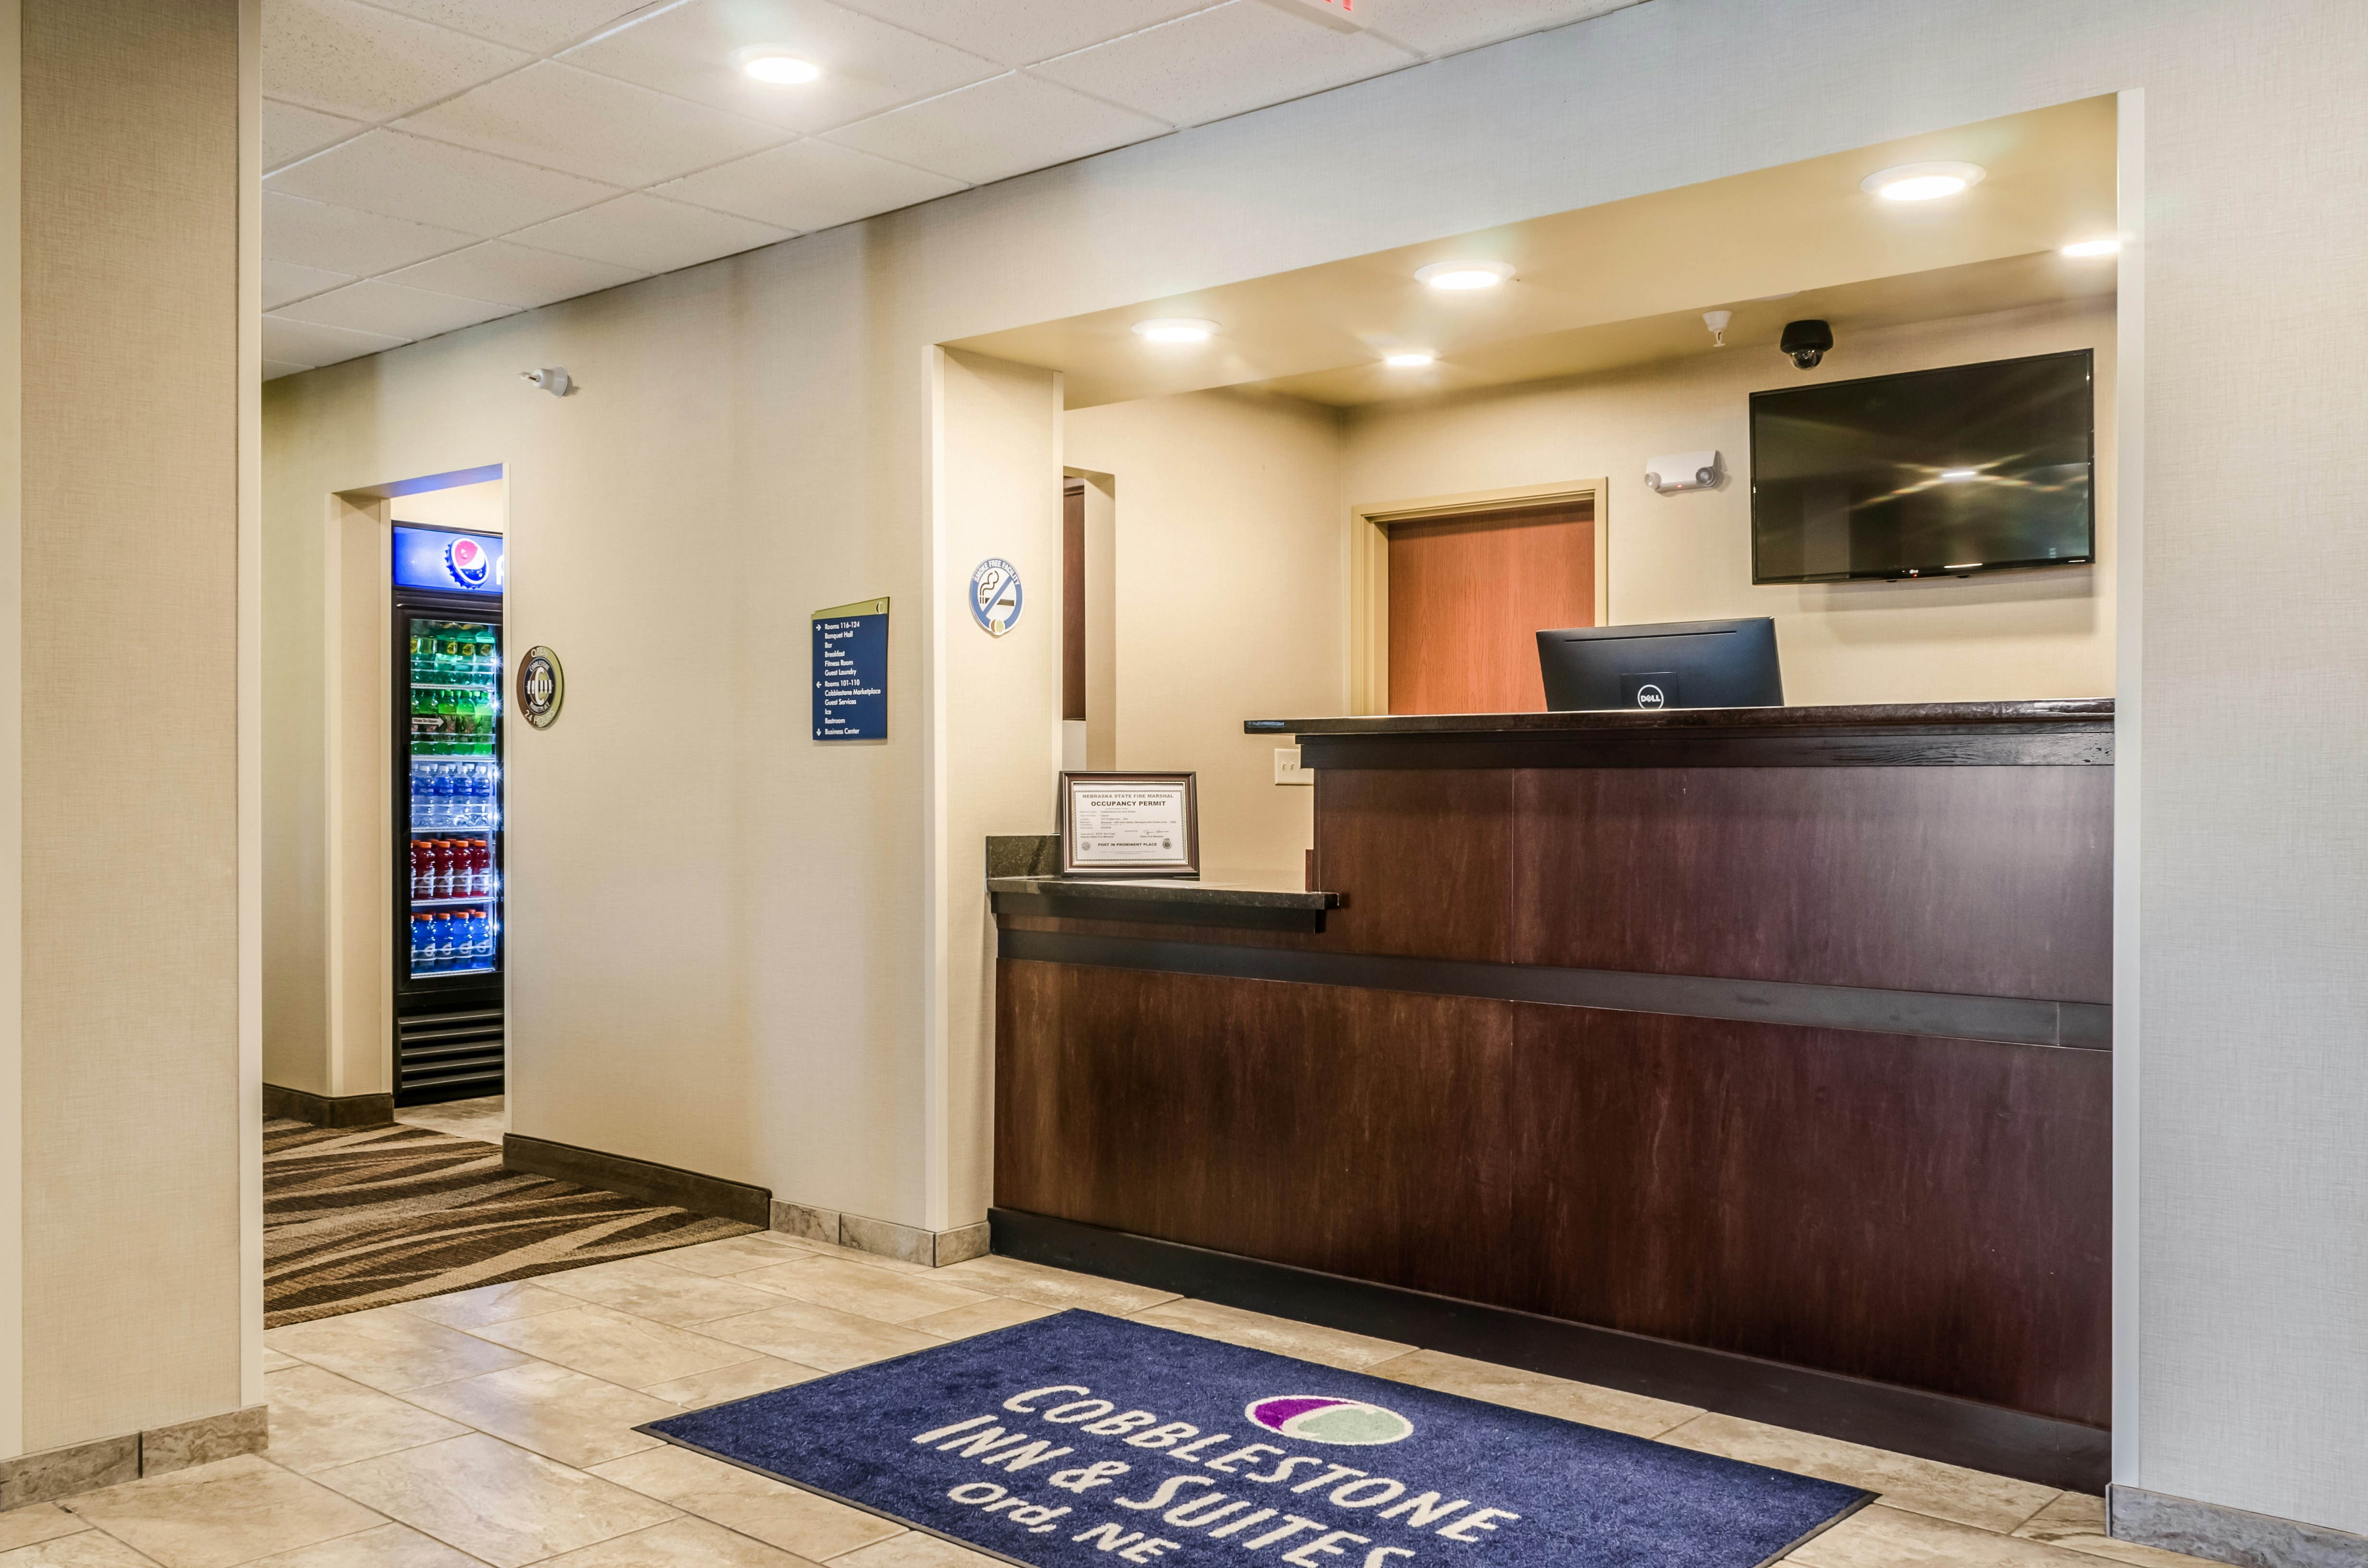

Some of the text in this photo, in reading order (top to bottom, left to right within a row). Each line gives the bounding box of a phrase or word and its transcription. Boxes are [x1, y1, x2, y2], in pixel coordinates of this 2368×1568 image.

[974, 562, 989, 583] SMOKE
[1001, 562, 1020, 585] FACILITY
[531, 647, 549, 658] OPEN
[524, 709, 555, 725] 24 HOURS
[912, 1414, 1074, 1472] INN
[1048, 1461, 1131, 1494] &
[1003, 1384, 1520, 1542] COBBLESTONE
[947, 1482, 1181, 1564] Ord, NE
